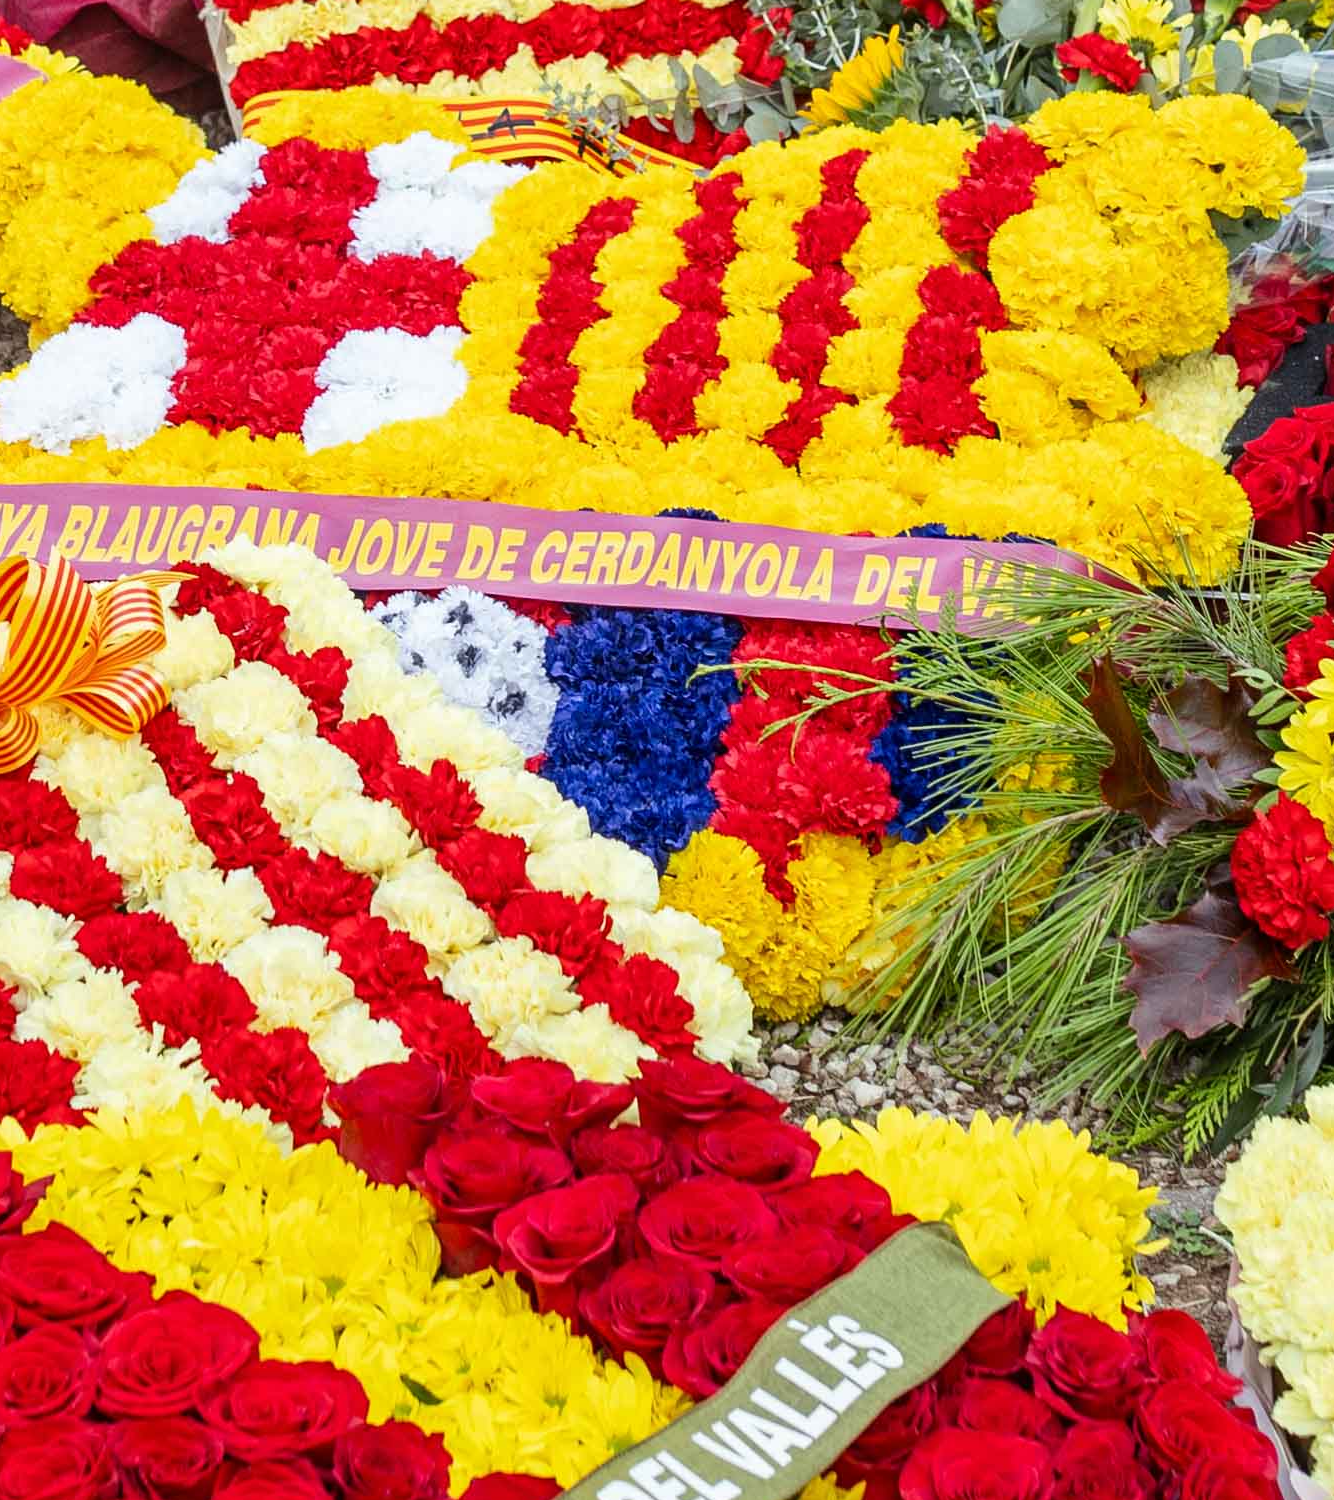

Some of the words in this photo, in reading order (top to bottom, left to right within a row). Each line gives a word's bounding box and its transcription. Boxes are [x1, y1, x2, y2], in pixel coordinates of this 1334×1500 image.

[326, 517, 454, 578] JOVE
[454, 525, 526, 584] DE
[529, 528, 835, 603] CERDANYOLA
[852, 553, 946, 613] DEL
[696, 1314, 906, 1483] VALLÈS
